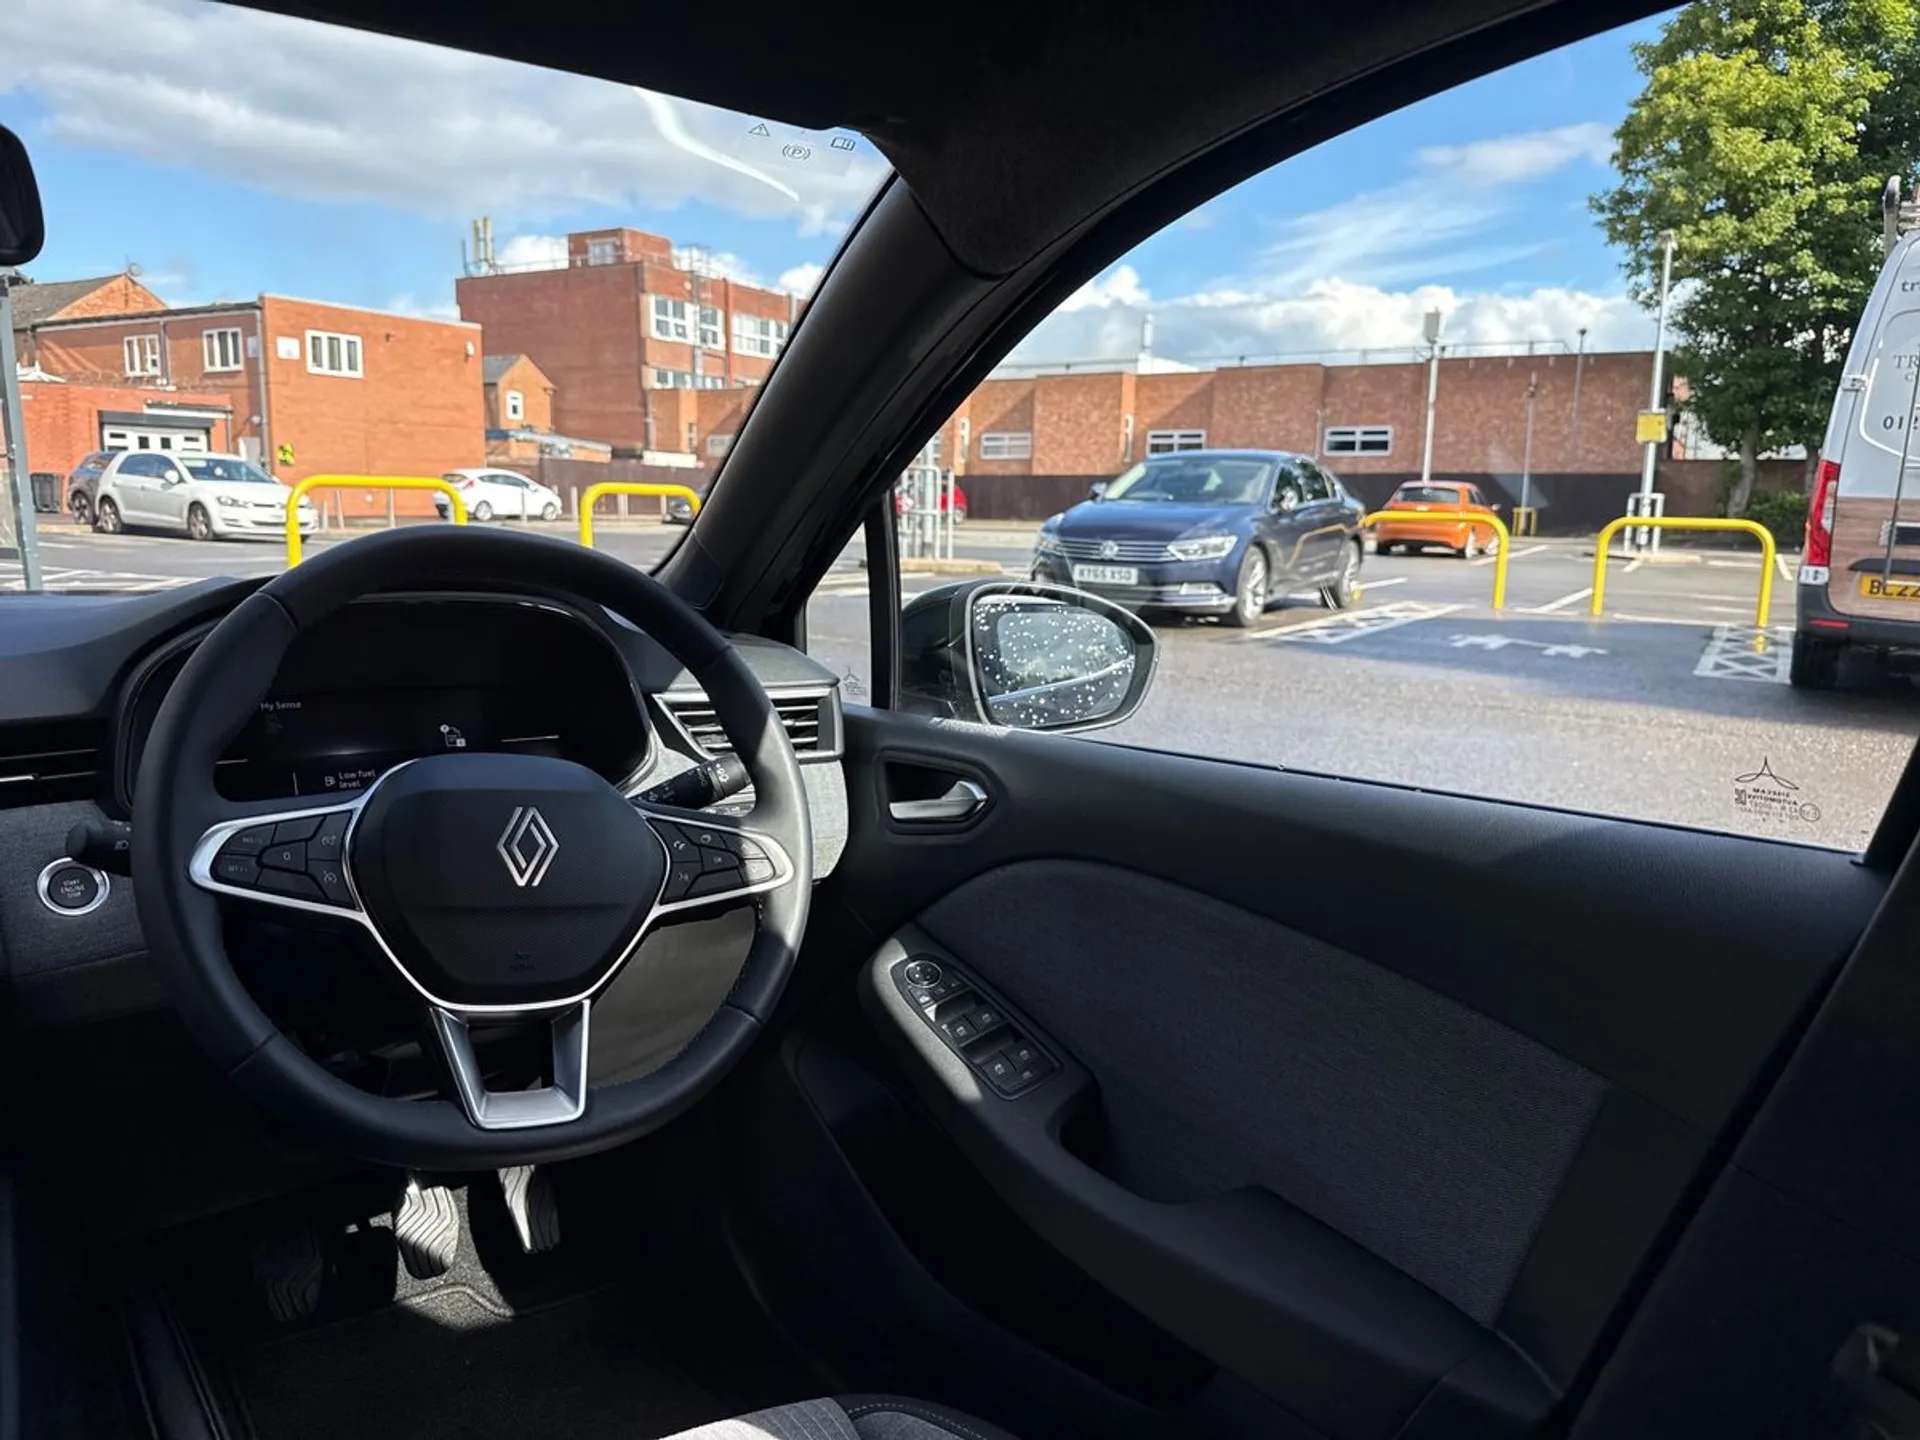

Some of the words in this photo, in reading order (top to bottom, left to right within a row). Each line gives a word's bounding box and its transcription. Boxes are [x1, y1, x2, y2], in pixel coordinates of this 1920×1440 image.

[1901, 280, 1920, 292] tr
[338, 771, 356, 780] Low
[358, 769, 376, 778] fuel
[339, 780, 360, 789] level
